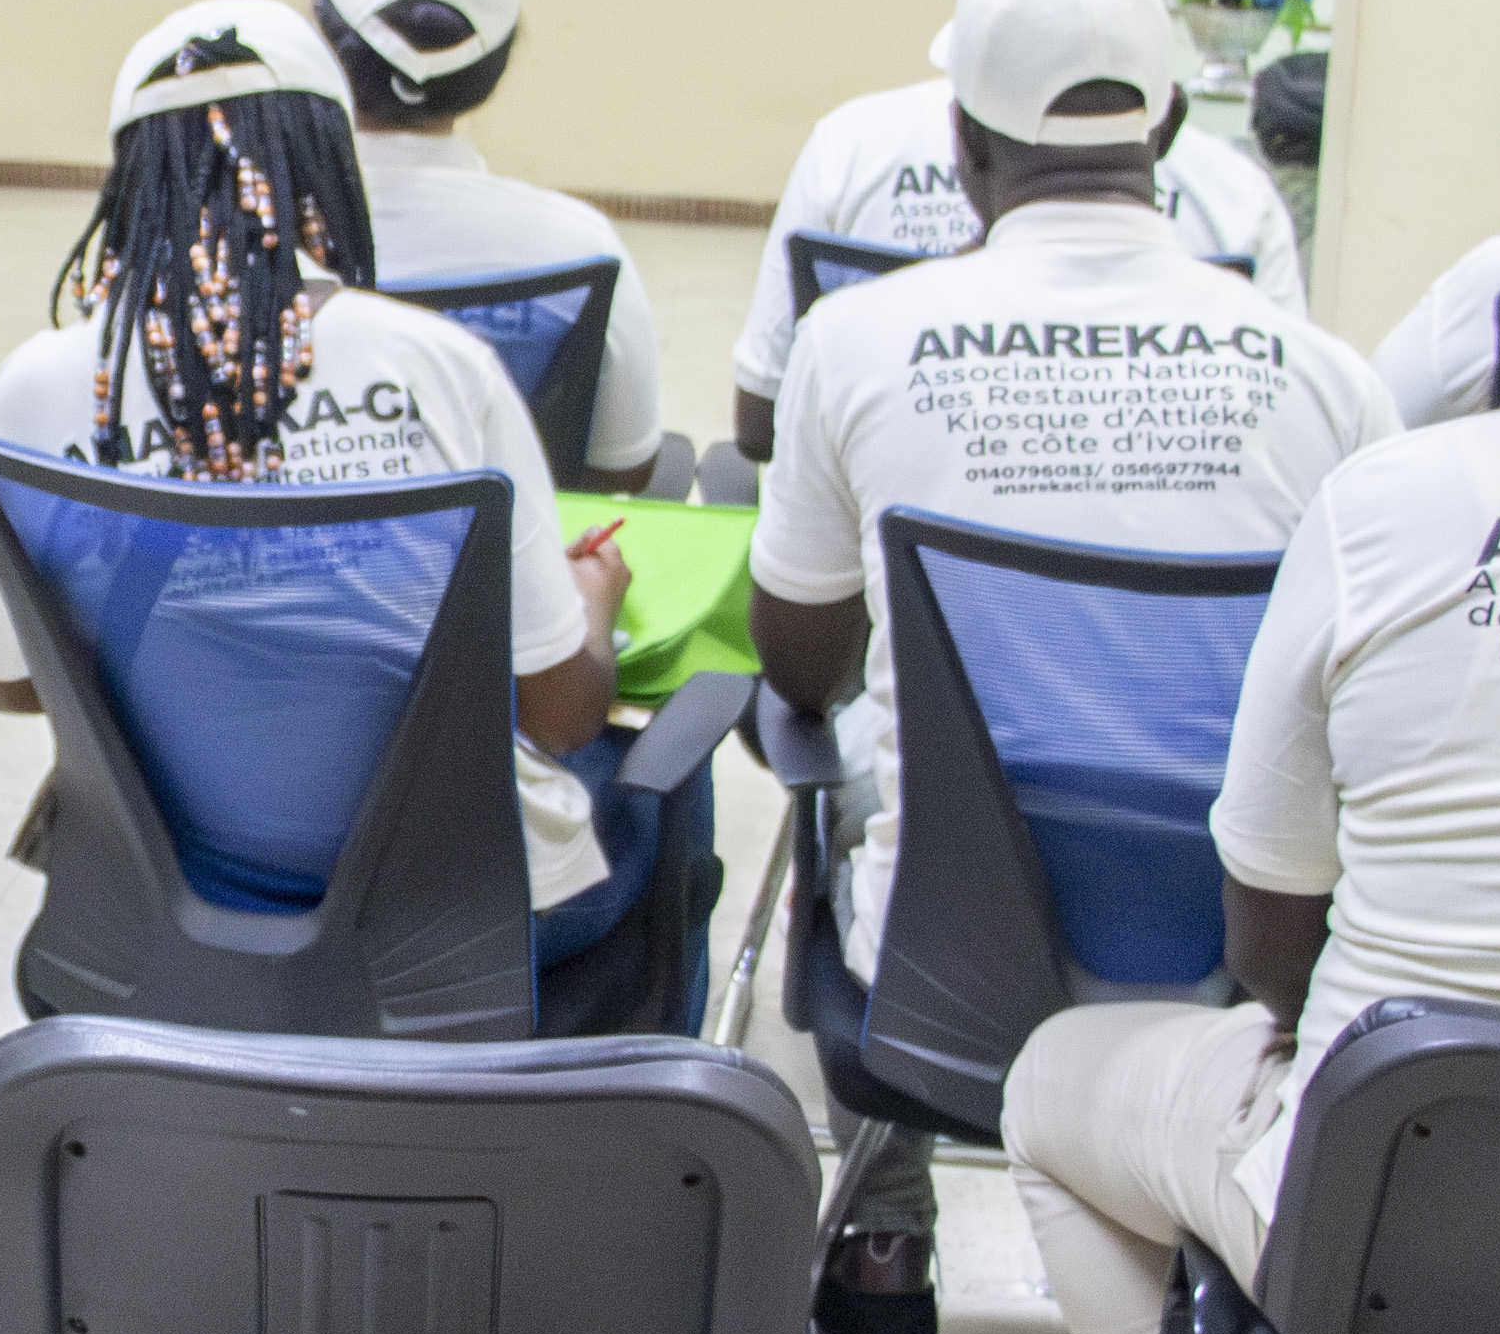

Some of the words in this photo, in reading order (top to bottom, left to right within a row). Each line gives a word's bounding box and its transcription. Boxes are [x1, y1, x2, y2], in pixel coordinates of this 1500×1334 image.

[908, 322, 1284, 368] ANAREKA-CI
[908, 361, 1113, 392] Association
[1127, 361, 1288, 392] Nationale
[914, 386, 973, 415] des
[988, 384, 1234, 407] Restaurateurs
[1248, 388, 1276, 412] et
[946, 409, 1089, 434] Kiosque
[289, 423, 425, 461] ationale
[966, 436, 1008, 457] de
[1022, 432, 1098, 454] côte
[382, 454, 413, 475] et
